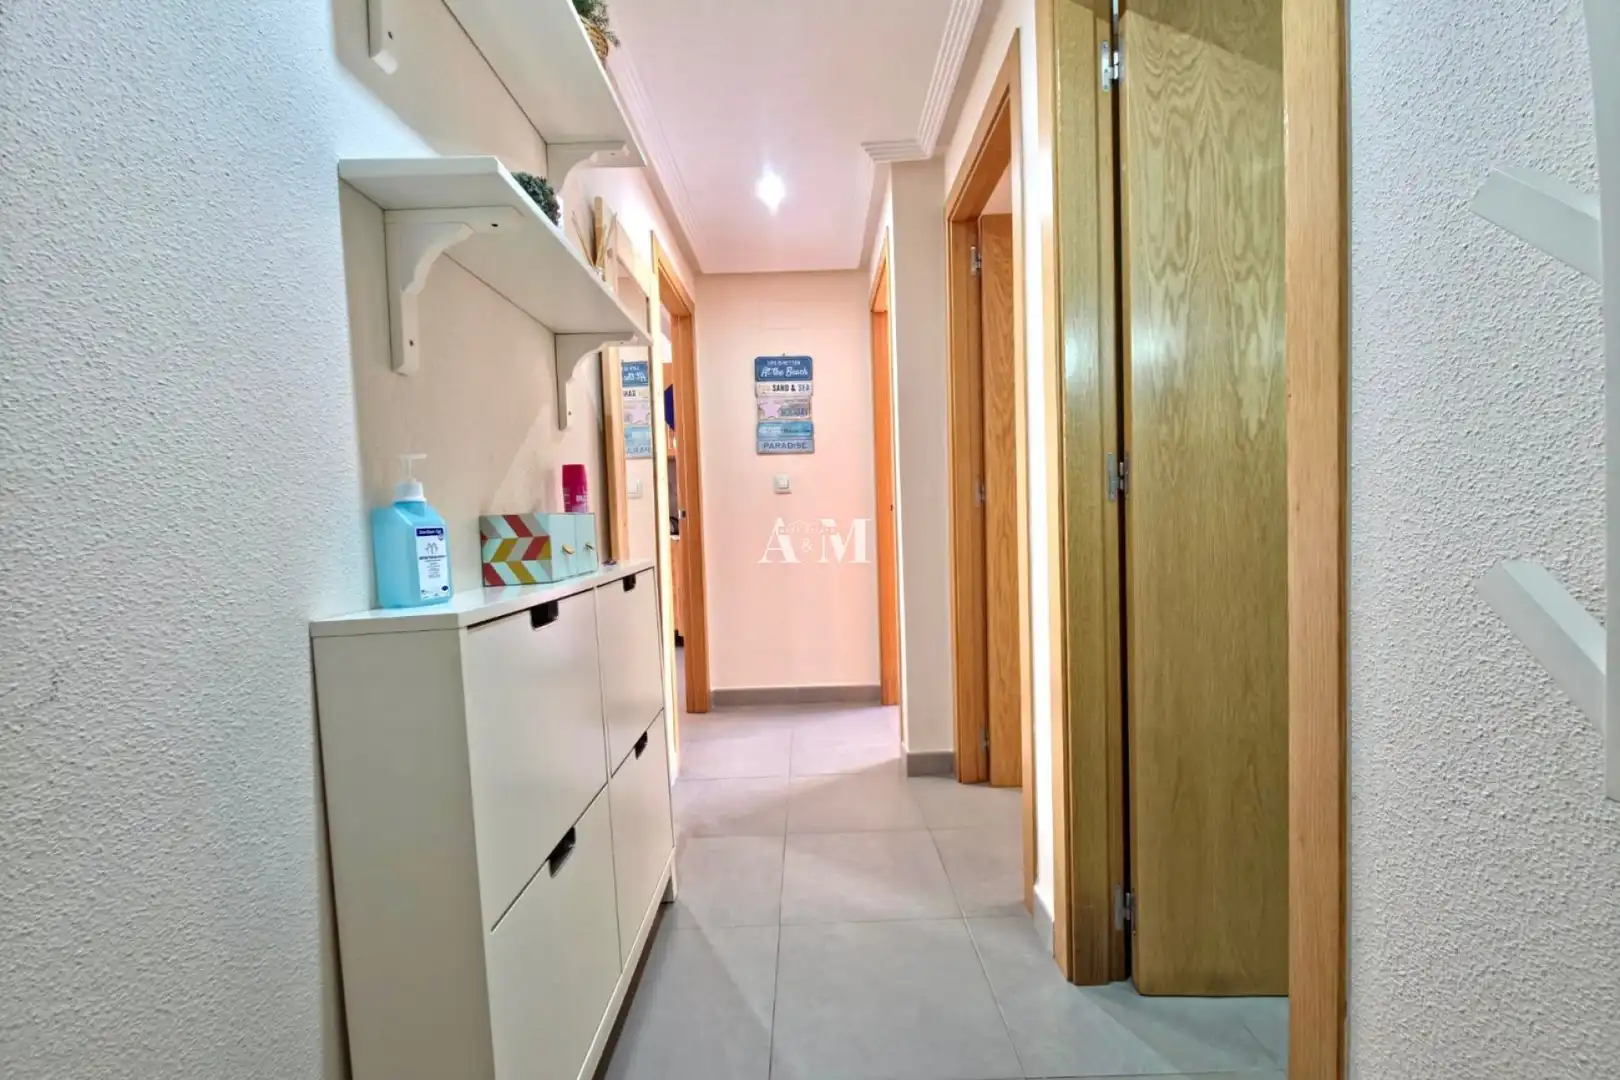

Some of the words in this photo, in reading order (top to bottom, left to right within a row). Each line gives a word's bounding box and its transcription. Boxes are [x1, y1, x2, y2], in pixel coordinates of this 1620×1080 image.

[785, 366, 808, 377] Beach
[772, 383, 789, 392] SAND
[790, 383, 797, 392] &
[798, 383, 810, 392] SEA
